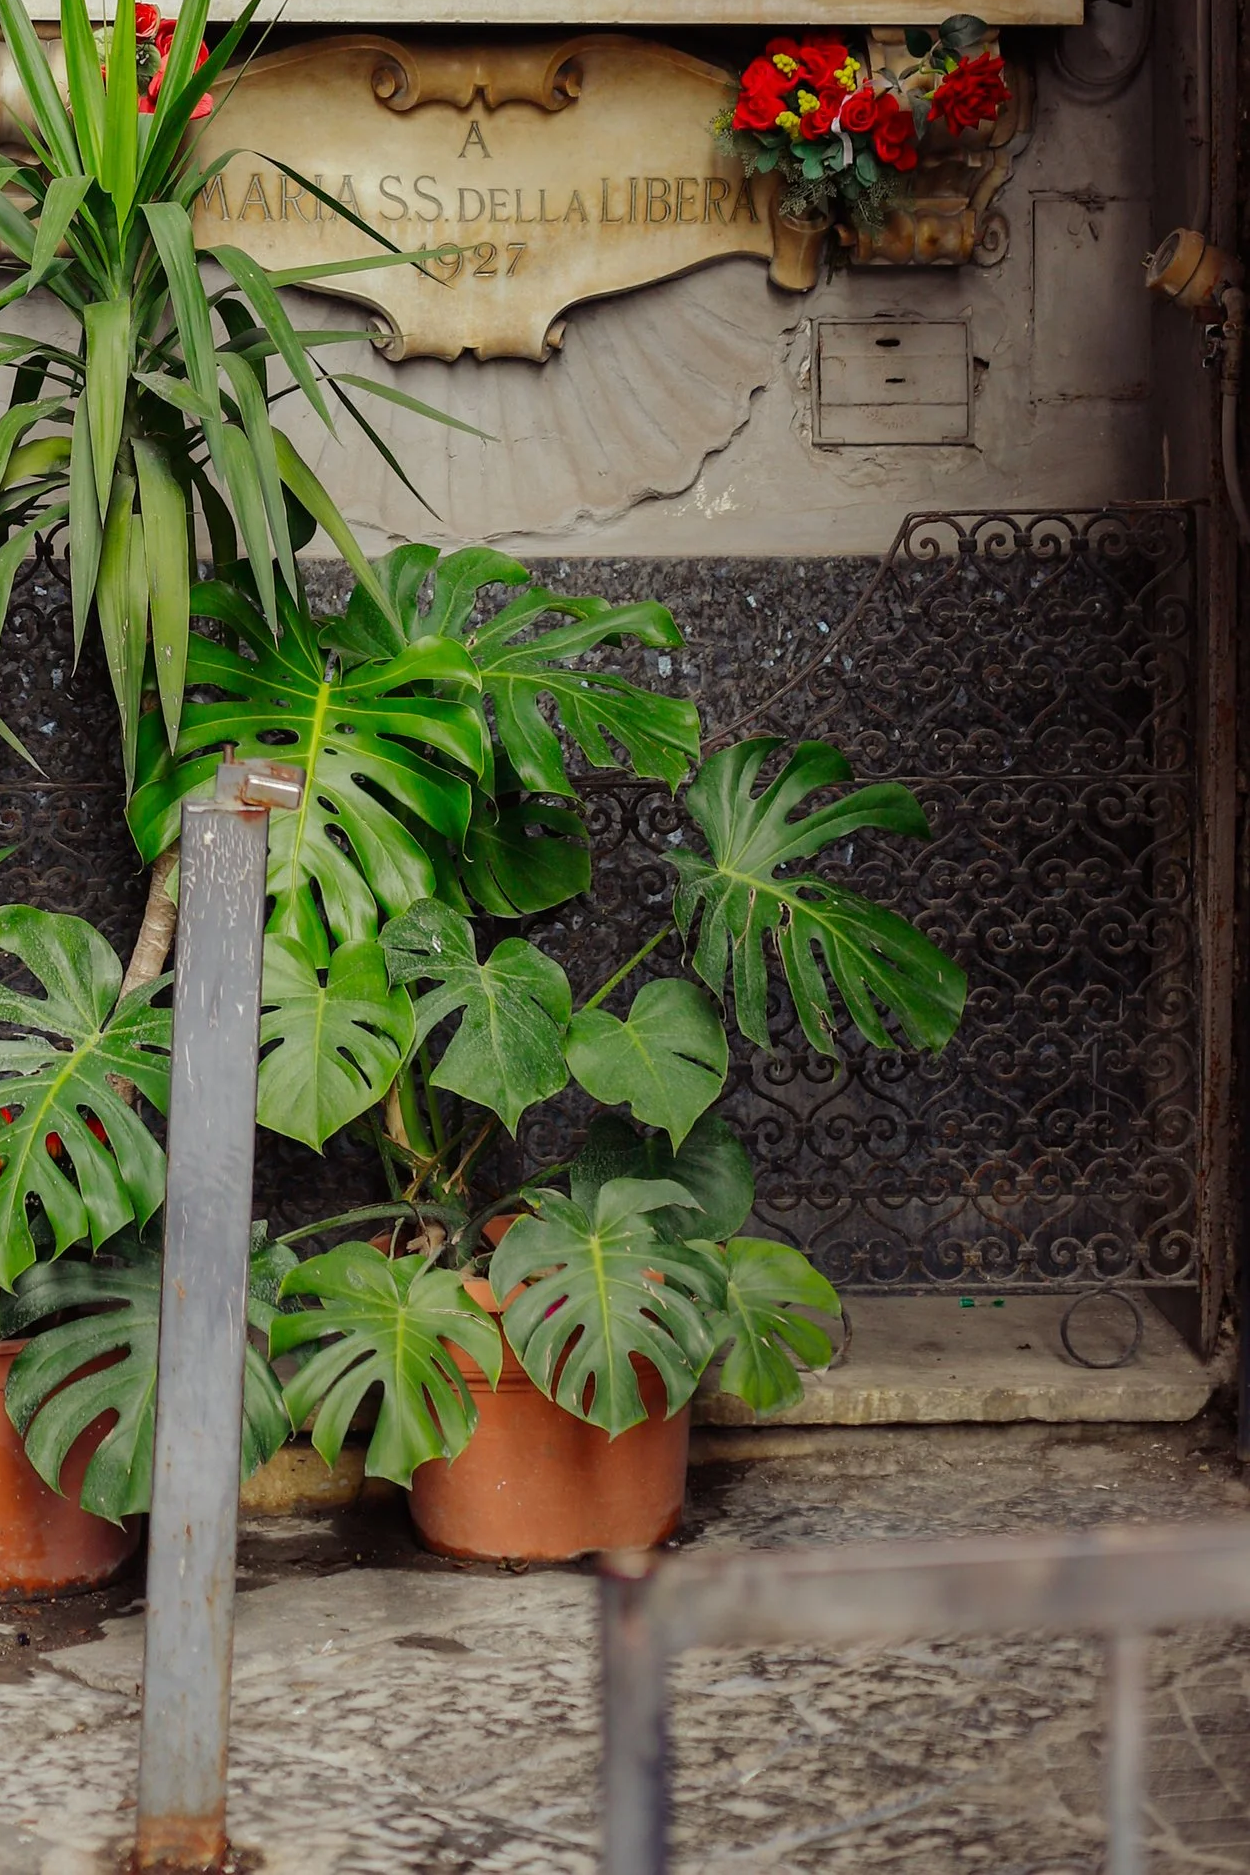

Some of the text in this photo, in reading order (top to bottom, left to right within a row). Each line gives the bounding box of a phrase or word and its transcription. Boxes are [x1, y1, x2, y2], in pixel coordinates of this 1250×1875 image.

[457, 120, 493, 159] A
[457, 187, 590, 224] DELLA
[600, 177, 761, 225] LIBERA
[416, 241, 527, 283] 1927
